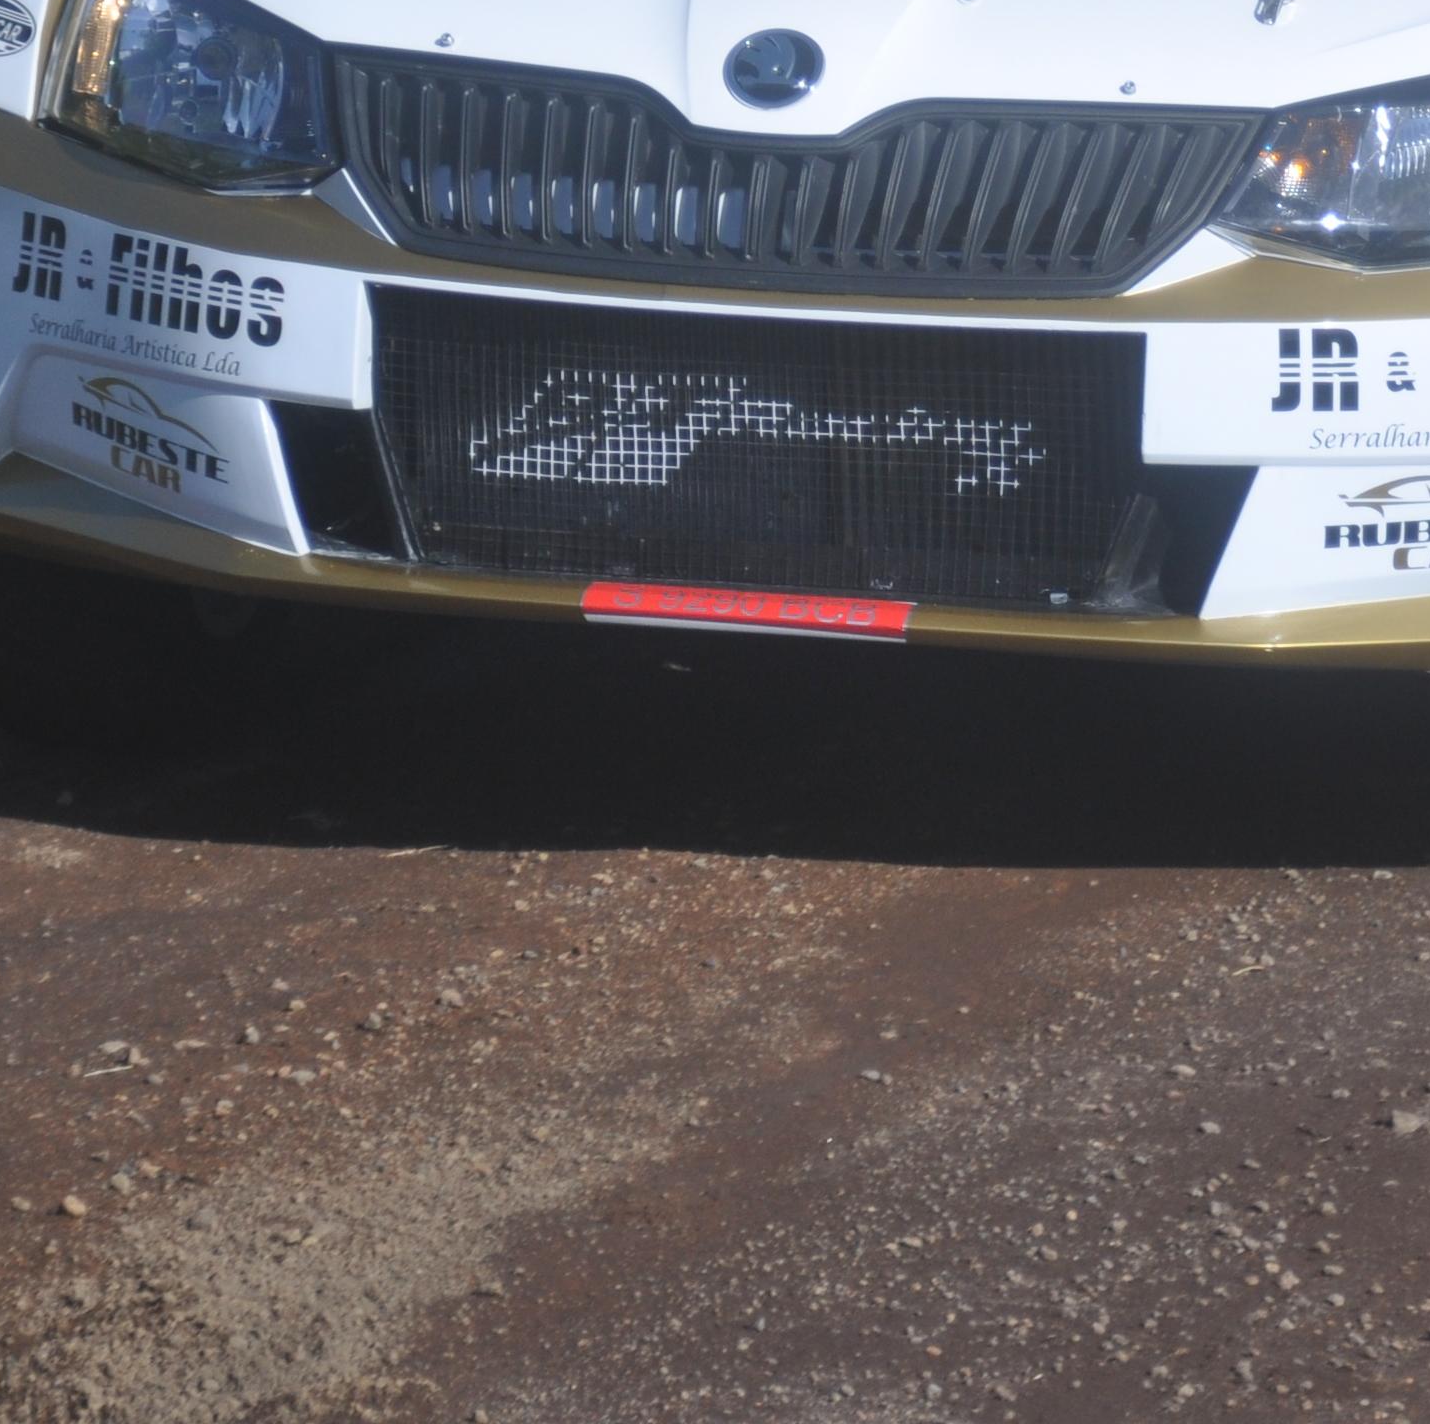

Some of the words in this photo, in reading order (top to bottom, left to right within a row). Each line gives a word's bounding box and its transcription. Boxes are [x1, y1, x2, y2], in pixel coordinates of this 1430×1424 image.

[12, 210, 67, 303] JR
[76, 248, 95, 292] &
[105, 232, 285, 348] Filhos
[28, 312, 117, 353] Serralharia
[201, 350, 241, 377] Lda
[1272, 327, 1360, 412] JR
[1386, 351, 1416, 393] &
[71, 401, 231, 485] RUBESTE
[109, 444, 182, 495] CAR
